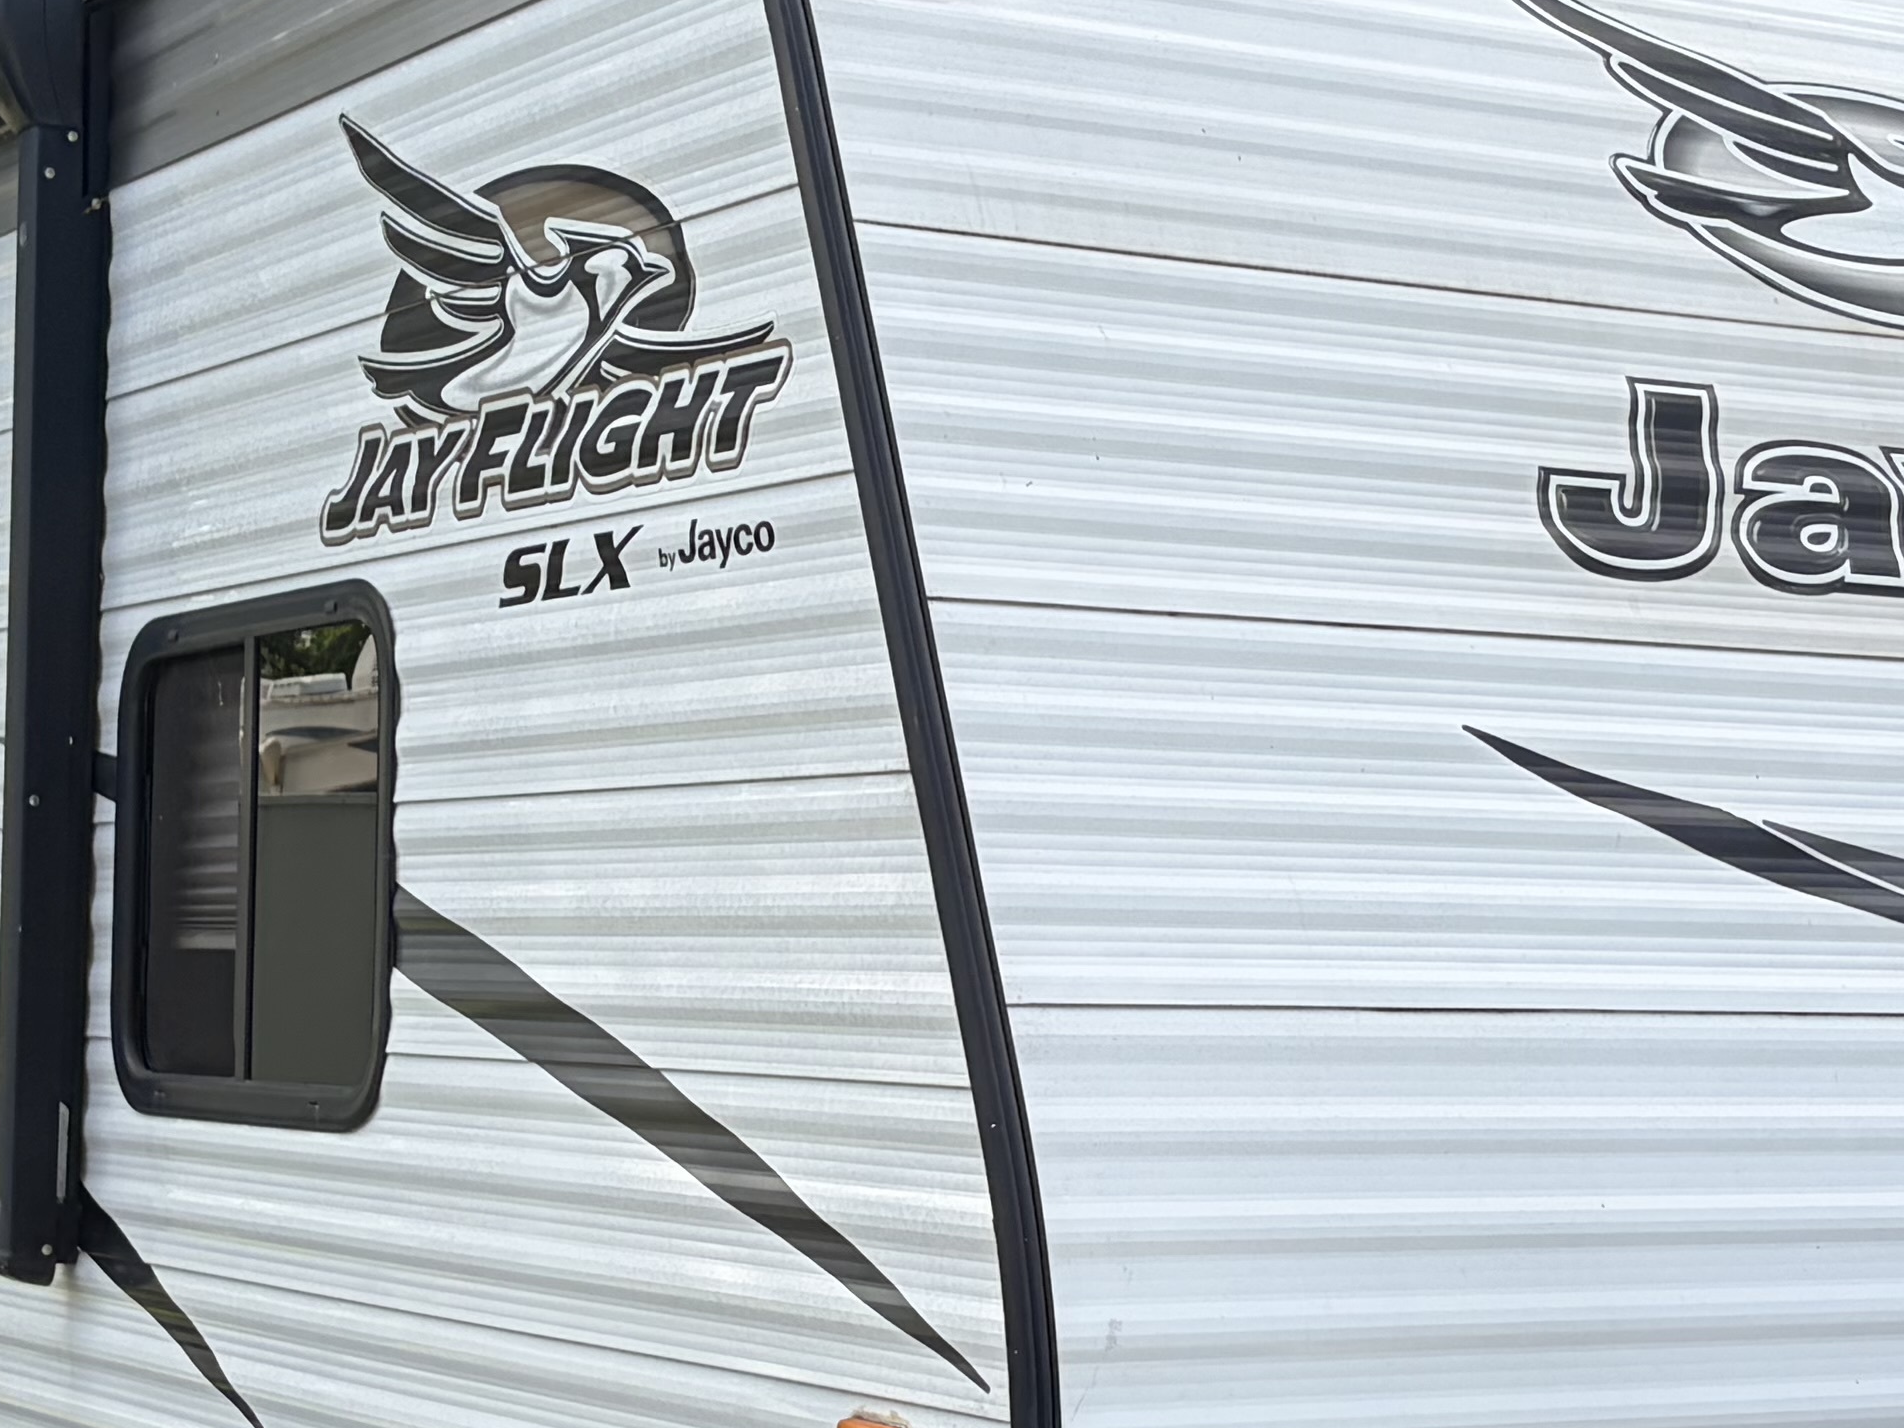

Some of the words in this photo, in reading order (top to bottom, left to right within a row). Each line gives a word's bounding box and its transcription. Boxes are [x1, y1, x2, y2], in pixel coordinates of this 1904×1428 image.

[498, 524, 645, 609] SLX
[658, 548, 676, 571] by
[676, 518, 776, 570] Jayco
